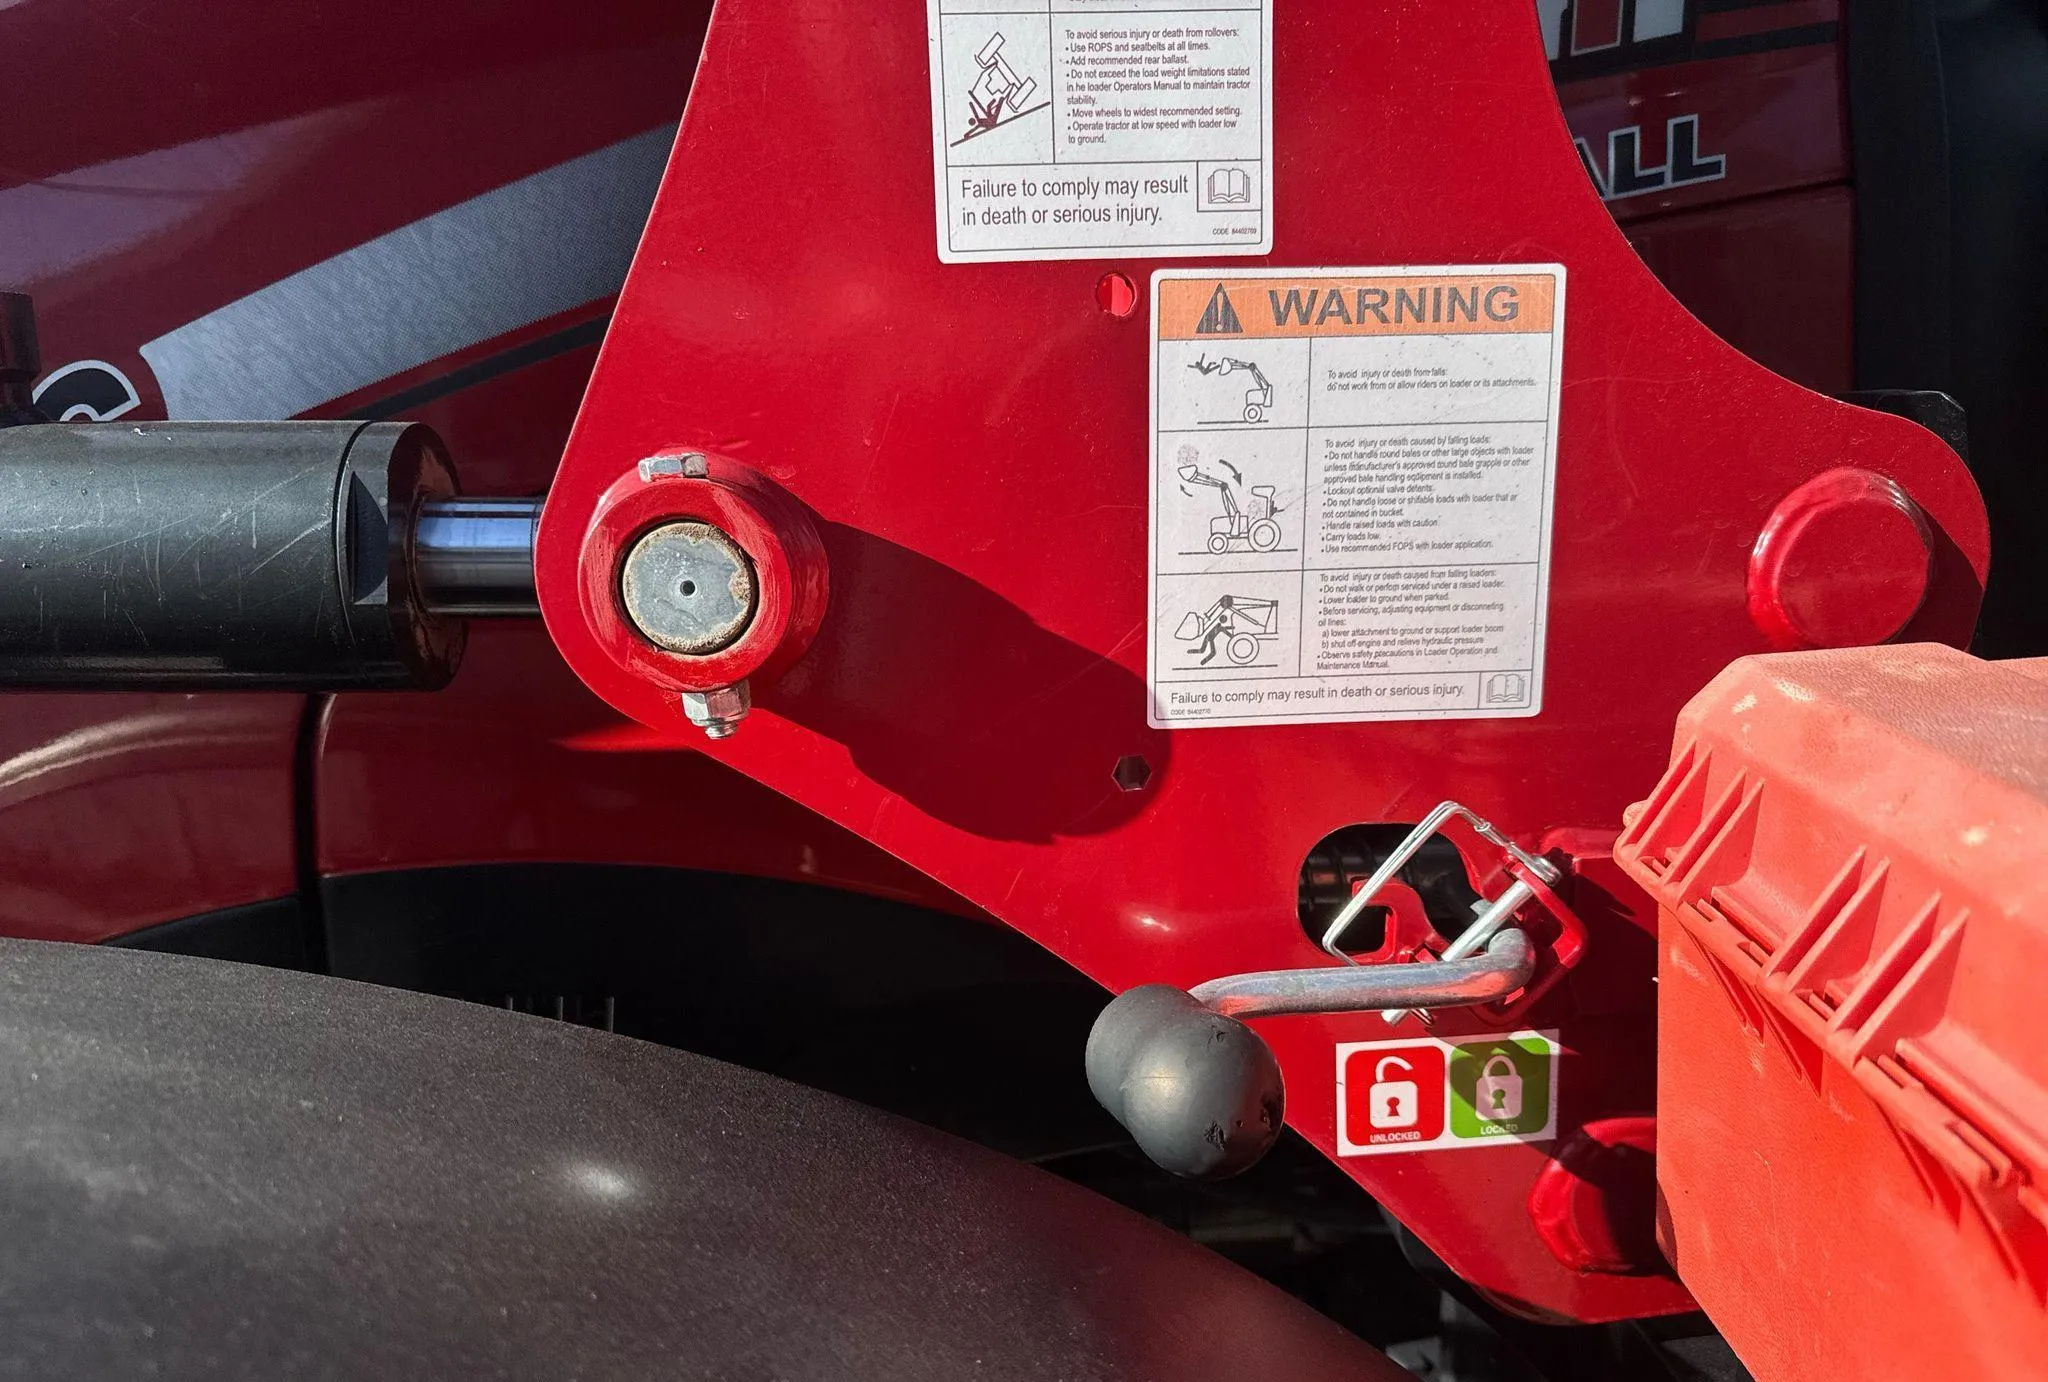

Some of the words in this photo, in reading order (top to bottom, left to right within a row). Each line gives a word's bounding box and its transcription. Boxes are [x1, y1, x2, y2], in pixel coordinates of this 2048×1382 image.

[1065, 29, 1075, 39] To
[1076, 29, 1098, 39] avoid
[1099, 28, 1127, 39] serious
[1128, 28, 1150, 40] injury
[1151, 30, 1160, 38] or
[1161, 28, 1184, 38] death
[1185, 27, 1203, 37] from
[1204, 27, 1240, 37] rollovers:
[1069, 42, 1086, 52] Use
[1087, 41, 1112, 51] ROPS
[1114, 41, 1129, 51] and
[1130, 41, 1165, 51] seatbelts
[1167, 40, 1175, 50] at
[1176, 40, 1186, 50] all
[1187, 40, 1210, 50] times.
[1070, 55, 1086, 65] Add
[1087, 54, 1143, 65] recommended
[1144, 56, 1159, 64] rear
[1161, 54, 1189, 64] ballast.
[1070, 68, 1082, 78] Do
[1083, 68, 1097, 78] not
[1098, 67, 1126, 78] exceed
[1127, 67, 1140, 77] the
[1141, 67, 1159, 77] load
[1160, 67, 1185, 79] weight
[1186, 66, 1225, 76] limitations
[1226, 66, 1250, 76] stated
[1066, 82, 1073, 92] in
[1086, 81, 1111, 91] loader
[1113, 80, 1151, 93] Operators
[1152, 80, 1181, 90] Manual
[1182, 80, 1191, 90] to
[1192, 79, 1224, 89] maintain
[1226, 79, 1250, 89] tractor
[1066, 94, 1098, 107] stability.
[1072, 107, 1093, 117] Move
[1094, 107, 1122, 117] wheels
[1123, 107, 1131, 117] to
[1132, 107, 1158, 117] widest
[1158, 106, 1213, 116] recommended
[1214, 105, 1242, 118] setting.
[1072, 120, 1103, 133] Operate
[1104, 120, 1129, 130] tractor
[1131, 120, 1139, 129] at
[1140, 119, 1154, 129] low
[1155, 119, 1179, 131] speed
[1180, 119, 1196, 129] with
[1197, 118, 1221, 128] loader
[1222, 118, 1237, 128] low
[1067, 134, 1075, 144] to
[1077, 133, 1106, 146] ground.
[961, 179, 1016, 198] Failure
[1021, 179, 1037, 197] to
[1041, 178, 1099, 200] comply
[1104, 181, 1139, 199] may
[1143, 176, 1187, 194] result
[962, 208, 976, 226] in
[981, 206, 1026, 225] death
[1031, 210, 1048, 224] or
[1052, 205, 1111, 224] serious
[1115, 204, 1162, 226] injury.
[1268, 285, 1520, 327] WARNING
[1370, 508, 1377, 517] in
[1170, 688, 1208, 703] Failure
[1211, 687, 1222, 702] to
[1224, 686, 1264, 705] comply
[1266, 688, 1291, 704] may
[1293, 684, 1325, 700] result
[1326, 684, 1338, 699] in
[1340, 683, 1372, 698] death
[1374, 686, 1386, 697] or
[1389, 681, 1430, 697] serious
[1432, 680, 1464, 699] injury.
[1480, 1123, 1518, 1136] LOCKED
[1369, 1131, 1421, 1144] UNLOCKED
